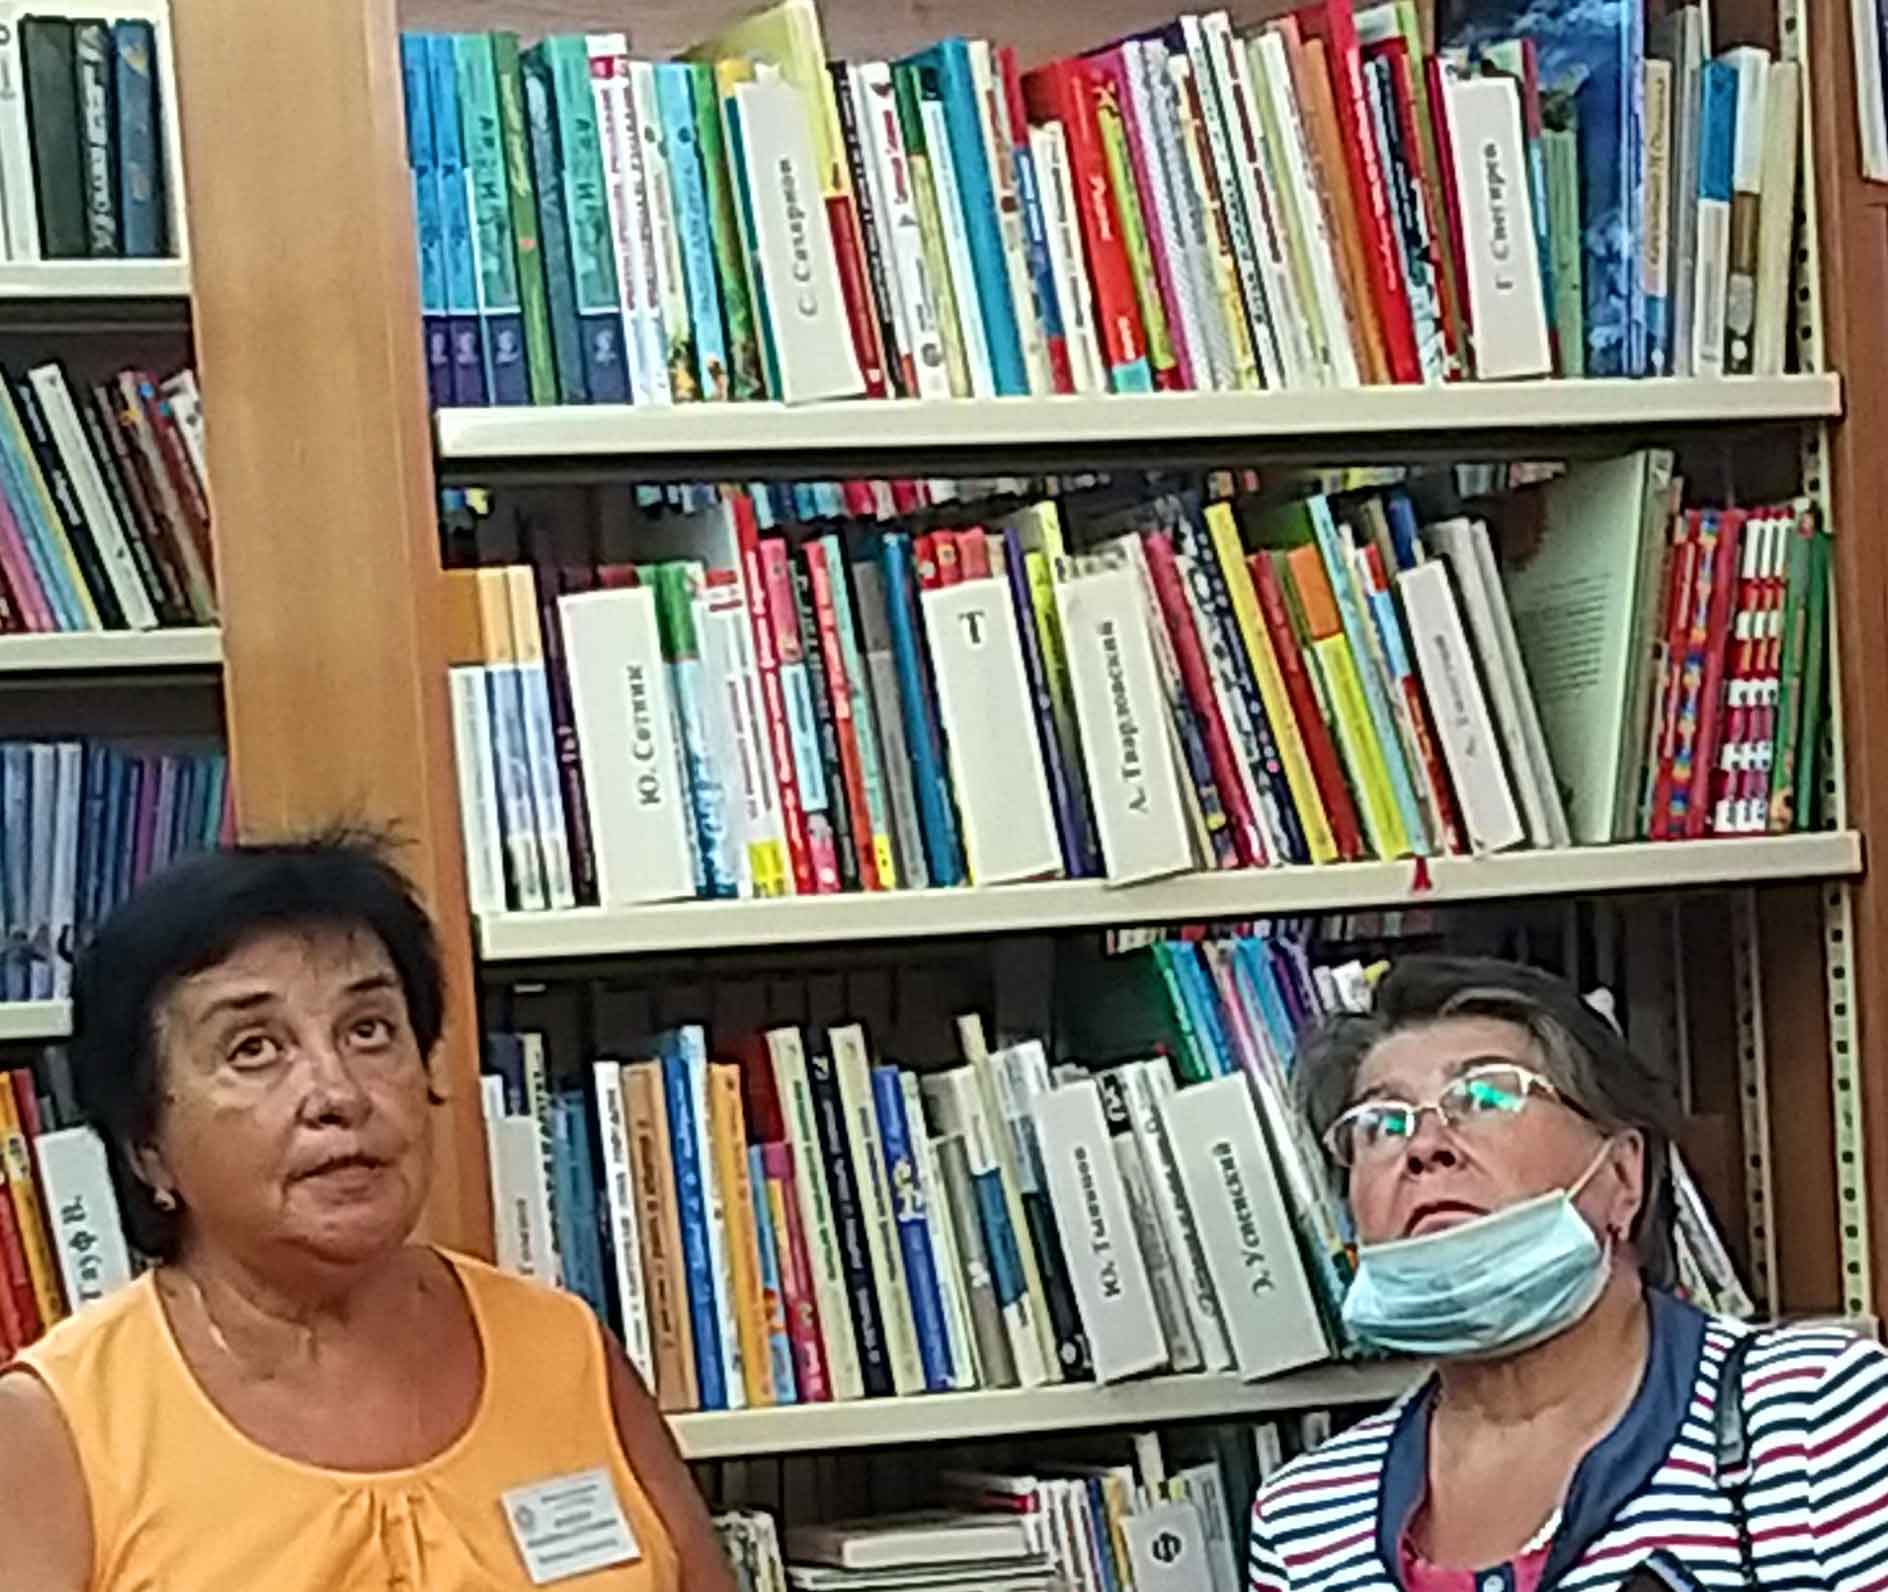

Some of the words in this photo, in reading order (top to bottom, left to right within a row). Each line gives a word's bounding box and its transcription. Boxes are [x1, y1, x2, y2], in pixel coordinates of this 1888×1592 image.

[958, 610, 985, 645] Т
[625, 664, 654, 761] Сотник
[1213, 1140, 1266, 1266] Успенский
[1152, 1531, 1182, 1563] Ф
